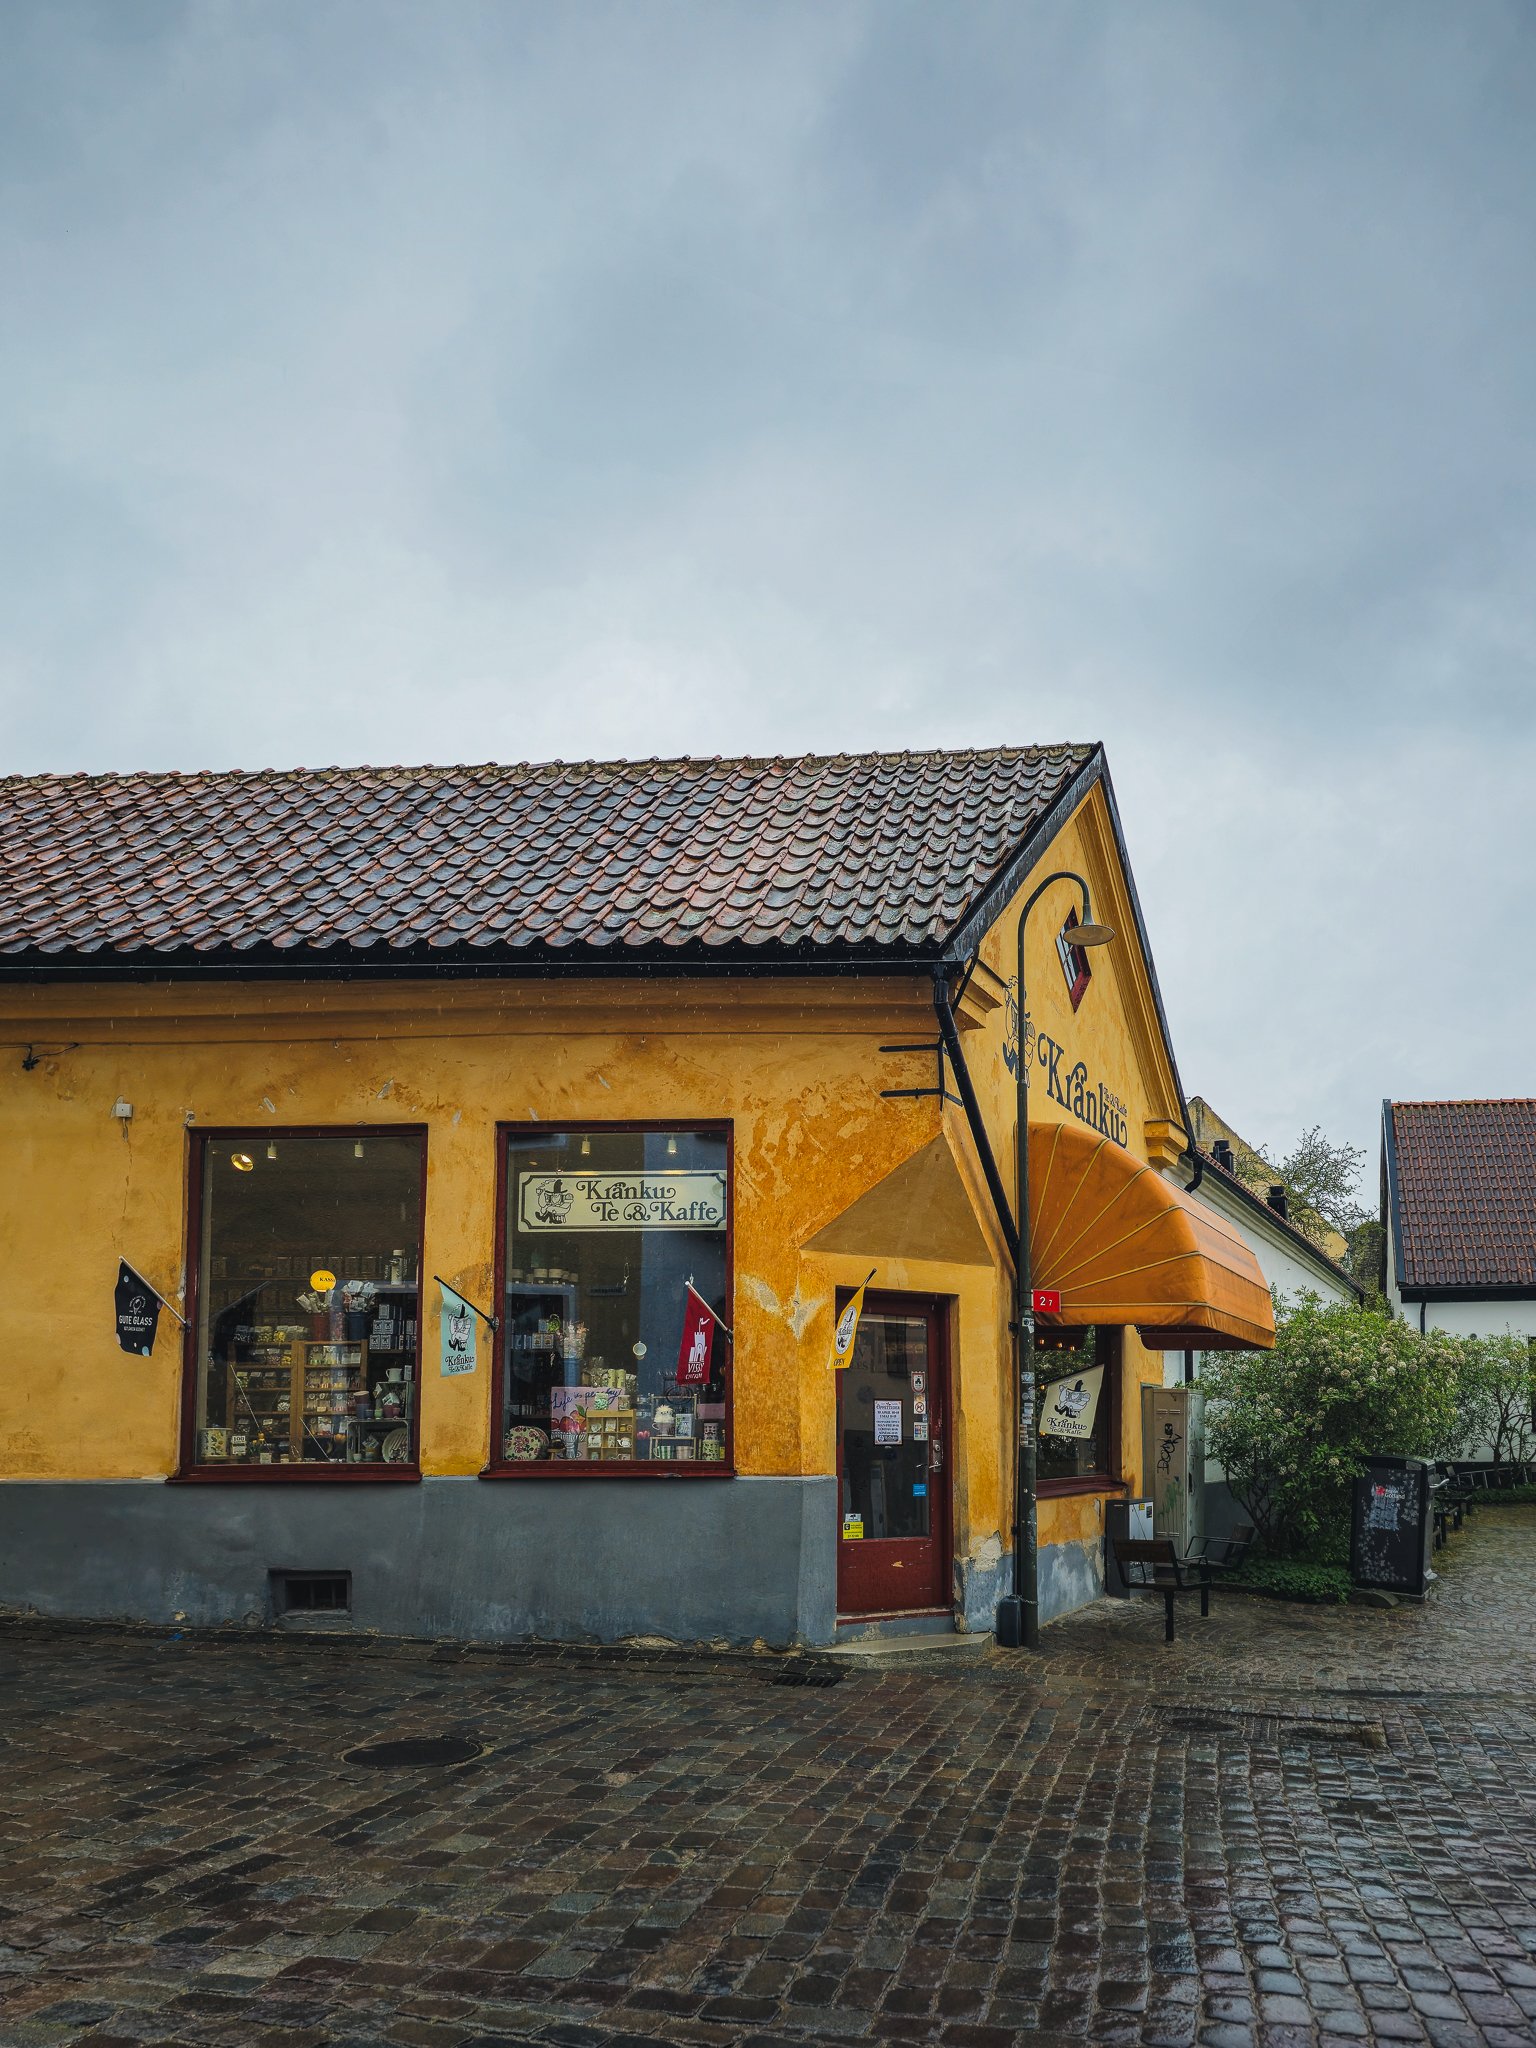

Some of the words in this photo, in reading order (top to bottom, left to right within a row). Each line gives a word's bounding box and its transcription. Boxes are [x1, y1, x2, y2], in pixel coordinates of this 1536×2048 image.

[1037, 1033, 1128, 1149] Kränku
[576, 1180, 676, 1200] Kränku
[591, 1201, 620, 1222] Te
[623, 1202, 651, 1222] &
[650, 1201, 718, 1221] Kaffe
[132, 1316, 153, 1326] GLASS
[1047, 1416, 1088, 1431] Kränku
